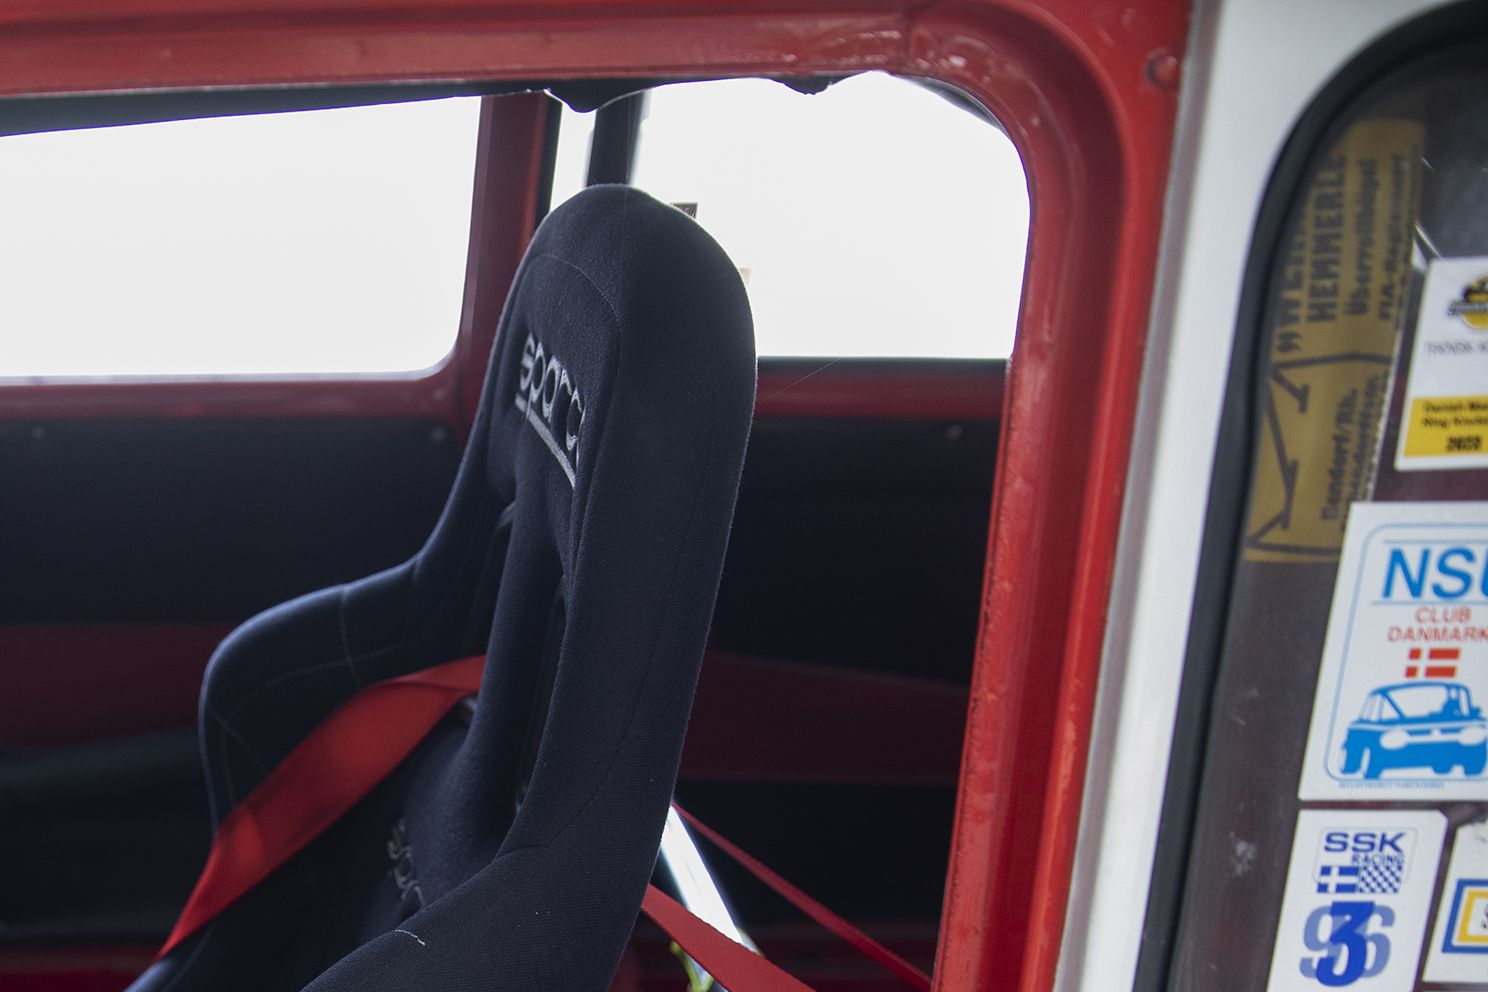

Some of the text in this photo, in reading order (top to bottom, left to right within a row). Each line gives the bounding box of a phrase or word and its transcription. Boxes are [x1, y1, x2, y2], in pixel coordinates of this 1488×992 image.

[519, 331, 586, 468] sparc
[1414, 606, 1472, 623] CLUB
[1324, 832, 1406, 853] SSK
[1350, 853, 1405, 865] RACING
